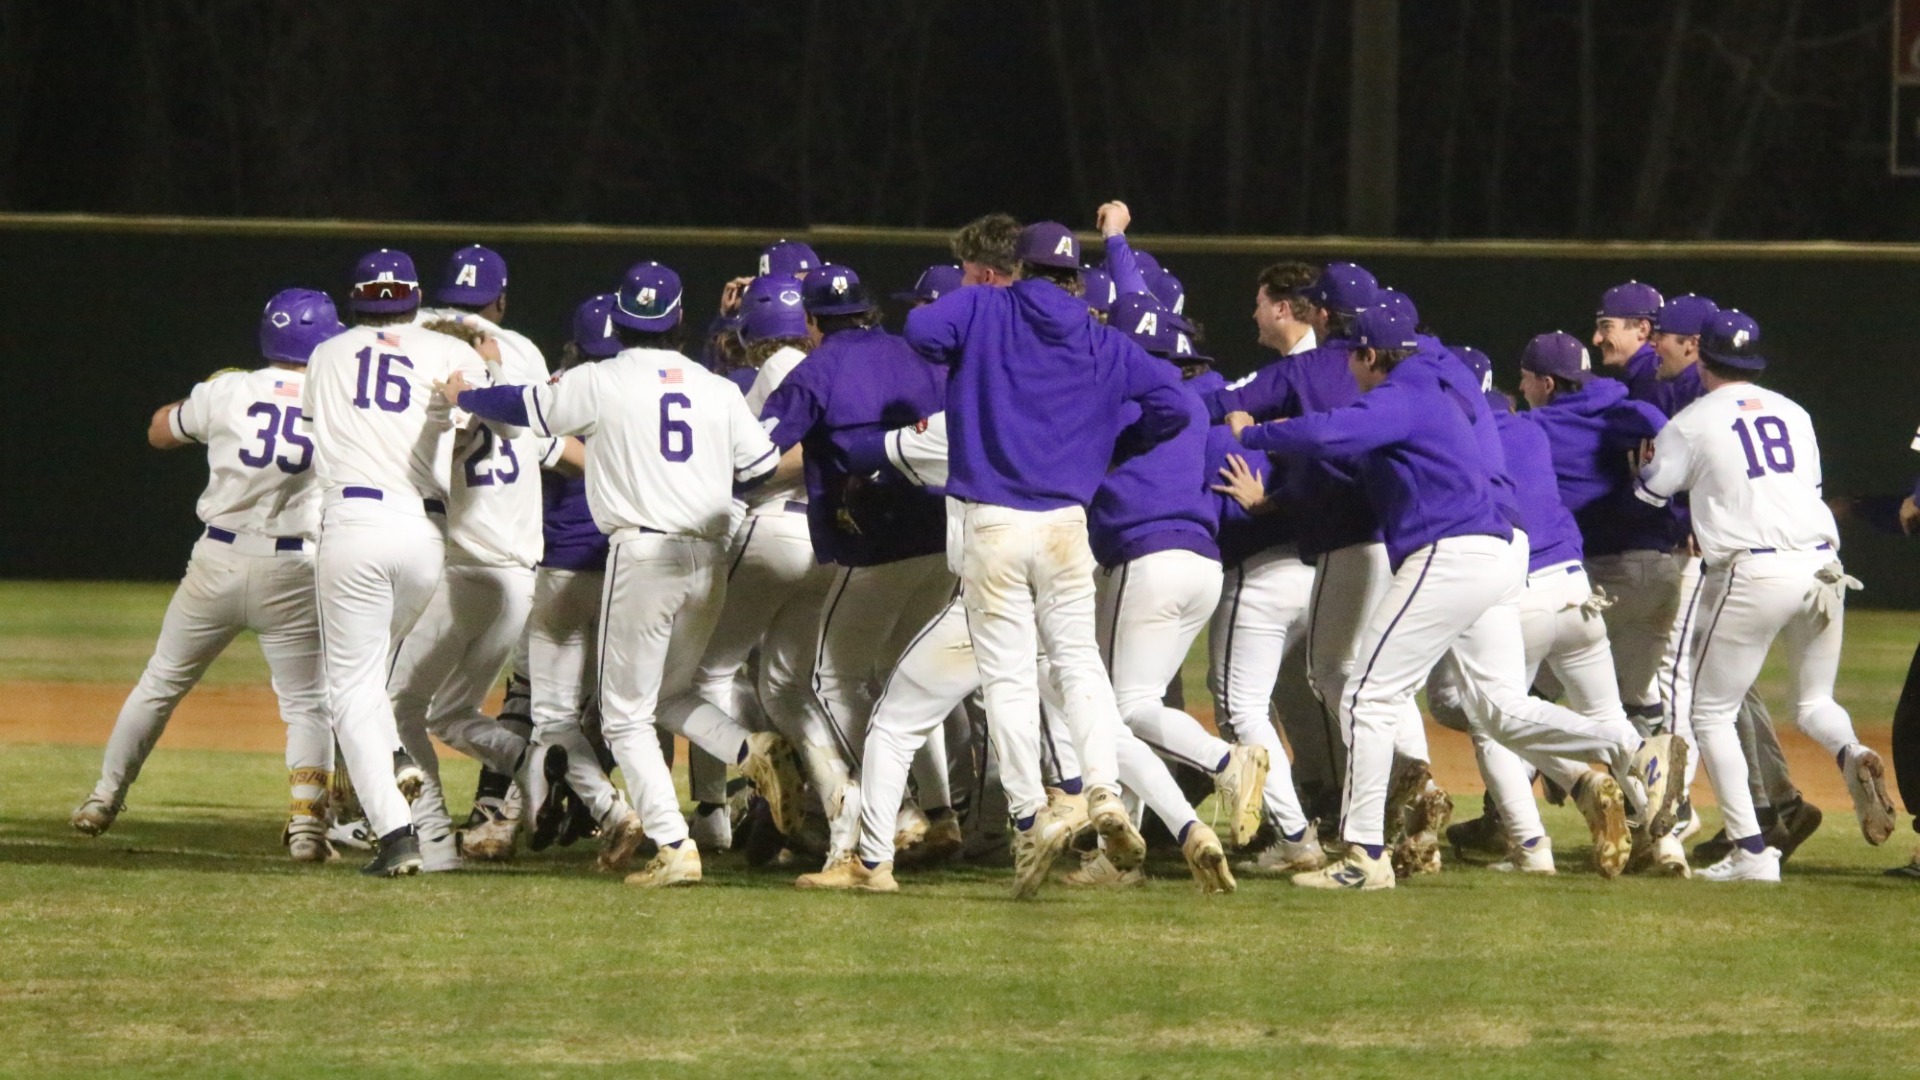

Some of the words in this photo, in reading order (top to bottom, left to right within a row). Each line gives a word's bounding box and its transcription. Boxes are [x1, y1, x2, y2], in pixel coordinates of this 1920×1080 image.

[455, 264, 477, 287] A
[1054, 236, 1073, 258] A
[1135, 312, 1157, 335] A
[1177, 333, 1191, 355] A
[353, 346, 414, 413] 16
[238, 402, 314, 474] 35
[464, 422, 520, 487] 23
[660, 392, 694, 463] 6
[1731, 415, 1796, 479] 18
